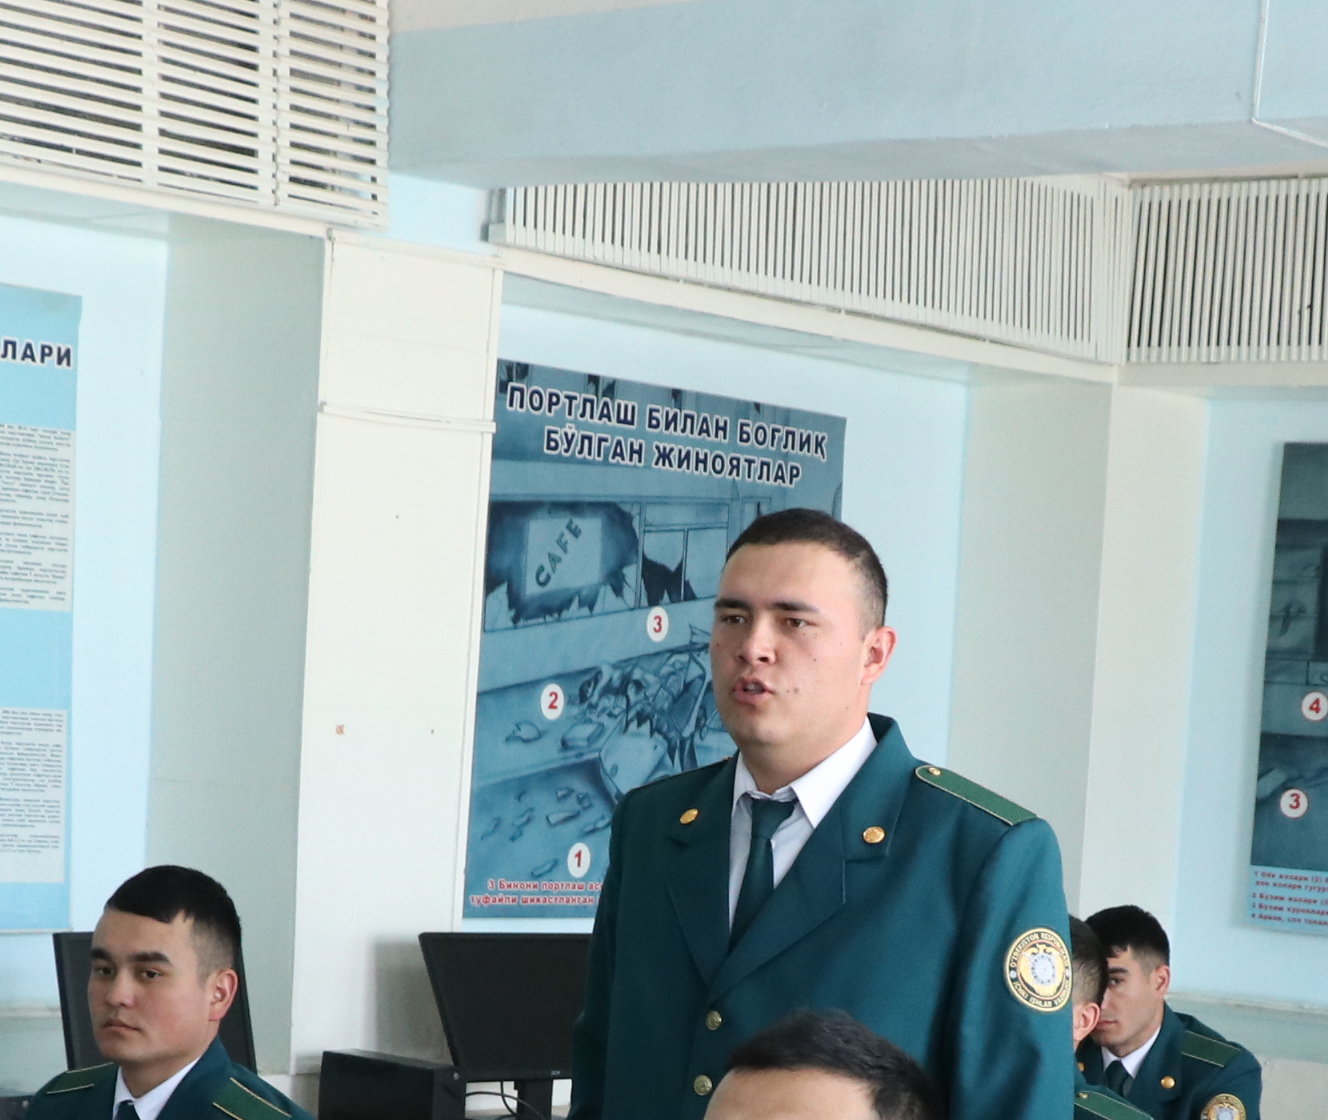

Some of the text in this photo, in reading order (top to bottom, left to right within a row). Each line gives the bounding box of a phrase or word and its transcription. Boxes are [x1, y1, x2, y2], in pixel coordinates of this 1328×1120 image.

[508, 386, 636, 426] ПОРТЛАШ
[648, 408, 728, 440] БИЛАН
[546, 425, 800, 485] БЎЛГАН ЖИНОЯТЛАР
[535, 519, 582, 587] CAFE
[653, 615, 663, 633] 3
[548, 692, 559, 710] 2
[1309, 698, 1321, 714] 4
[1290, 793, 1301, 809] 3
[573, 850, 583, 867] 1
[488, 880, 495, 889] 3
[499, 880, 538, 890] Бинони
[542, 882, 585, 892] портлаш
[470, 894, 594, 905] туфайли шикастланган
